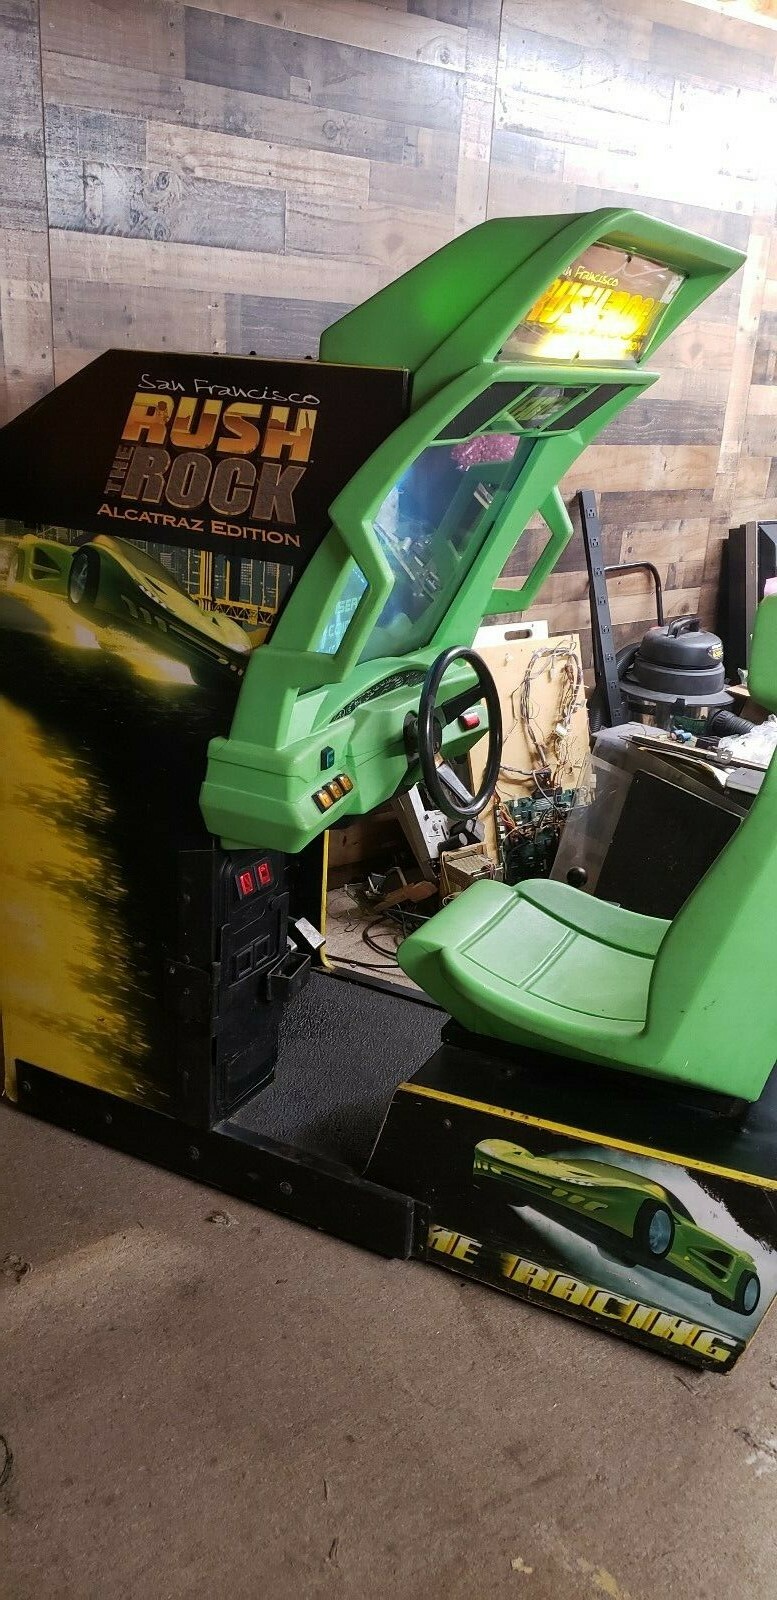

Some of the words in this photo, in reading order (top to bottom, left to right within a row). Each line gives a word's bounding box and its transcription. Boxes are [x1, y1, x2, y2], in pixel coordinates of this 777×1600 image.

[574, 265, 619, 287] Francisco
[137, 373, 186, 392] San
[194, 378, 321, 405] Francisco
[121, 391, 318, 463] RUSH
[104, 444, 136, 497] THE
[121, 446, 307, 525] ROCK
[96, 503, 204, 532] ALCATRAZ
[211, 520, 301, 548] EDITION
[500, 1251, 738, 1363] RACING
